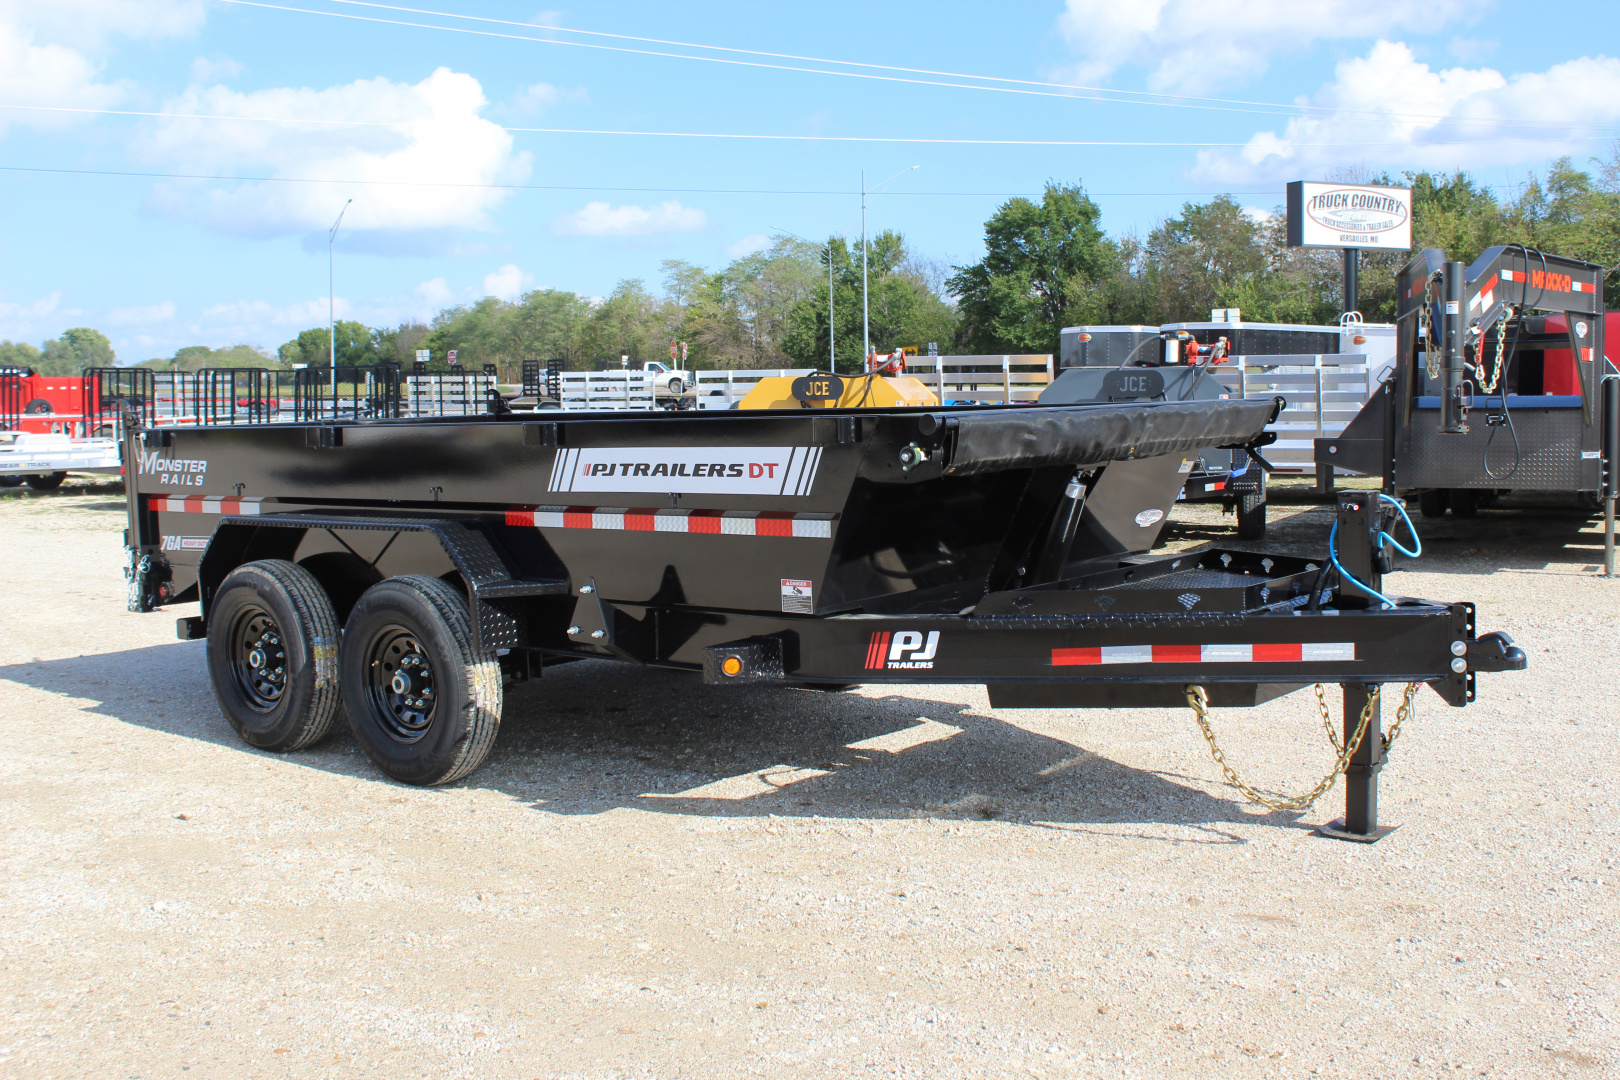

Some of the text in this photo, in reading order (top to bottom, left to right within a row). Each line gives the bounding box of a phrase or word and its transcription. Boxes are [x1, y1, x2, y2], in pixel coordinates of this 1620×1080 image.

[1312, 194, 1402, 213] TRUCK COUNTRY
[1322, 216, 1336, 225] TRUCK
[1336, 220, 1363, 231] ACCESSORIES
[1366, 222, 1382, 231] TRAILER
[1370, 235, 1379, 243] MO
[805, 381, 830, 396] JCE
[1120, 376, 1147, 392] JCE
[591, 462, 780, 479] PJ TRAILERS DT
[160, 473, 205, 486] RAILS
[160, 535, 182, 551] 7GA
[888, 630, 941, 661] PJ
[887, 661, 934, 670] TRAILERS
